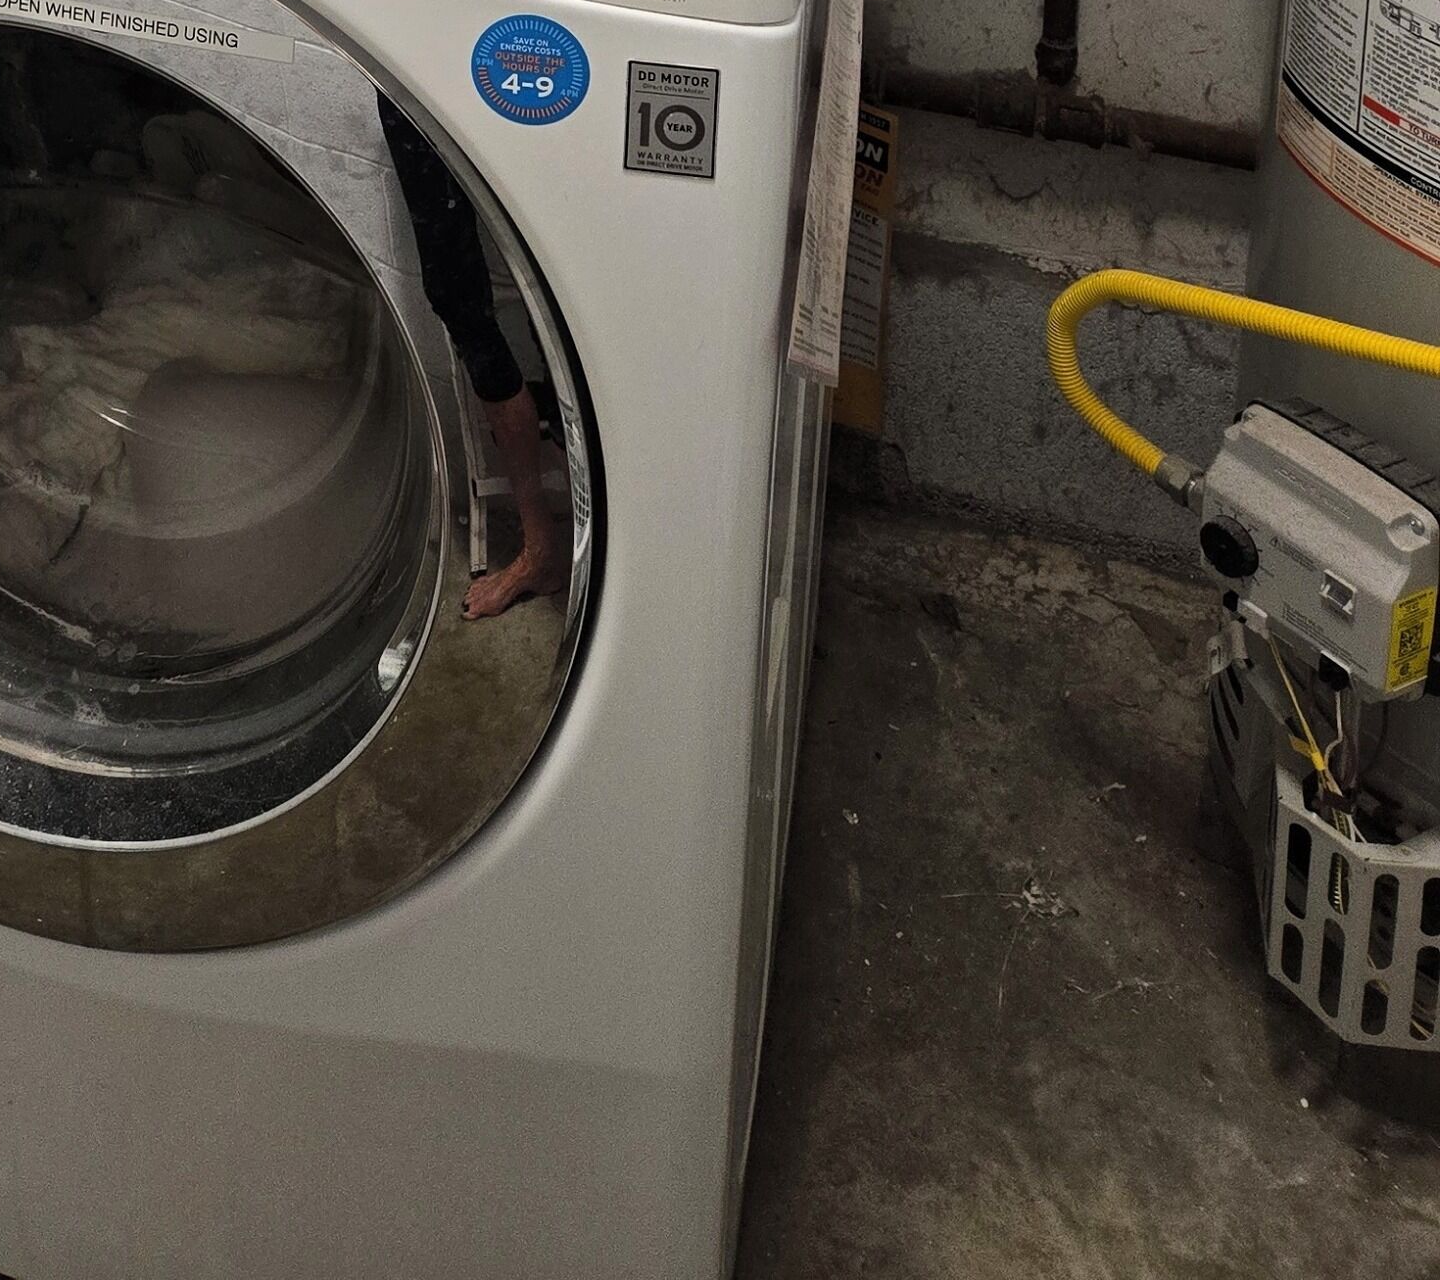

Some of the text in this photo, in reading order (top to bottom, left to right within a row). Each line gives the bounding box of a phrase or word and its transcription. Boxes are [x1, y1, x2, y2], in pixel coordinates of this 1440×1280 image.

[46, 2, 95, 23] WHEN
[100, 11, 179, 38] FINISHED
[184, 26, 239, 48] USING
[513, 36, 549, 47] SAVE ON
[500, 42, 562, 56] ENERGY COSTS
[495, 51, 566, 67] OUTSIDE THE
[502, 62, 558, 75] HOURS OF
[501, 73, 554, 98] 4-9
[638, 70, 709, 88] DD MOTOR
[642, 83, 663, 91] Direct
[664, 85, 682, 93] Drive
[637, 102, 706, 151] 10
[666, 122, 693, 133] YEAR
[637, 151, 704, 165] WARRANTY
